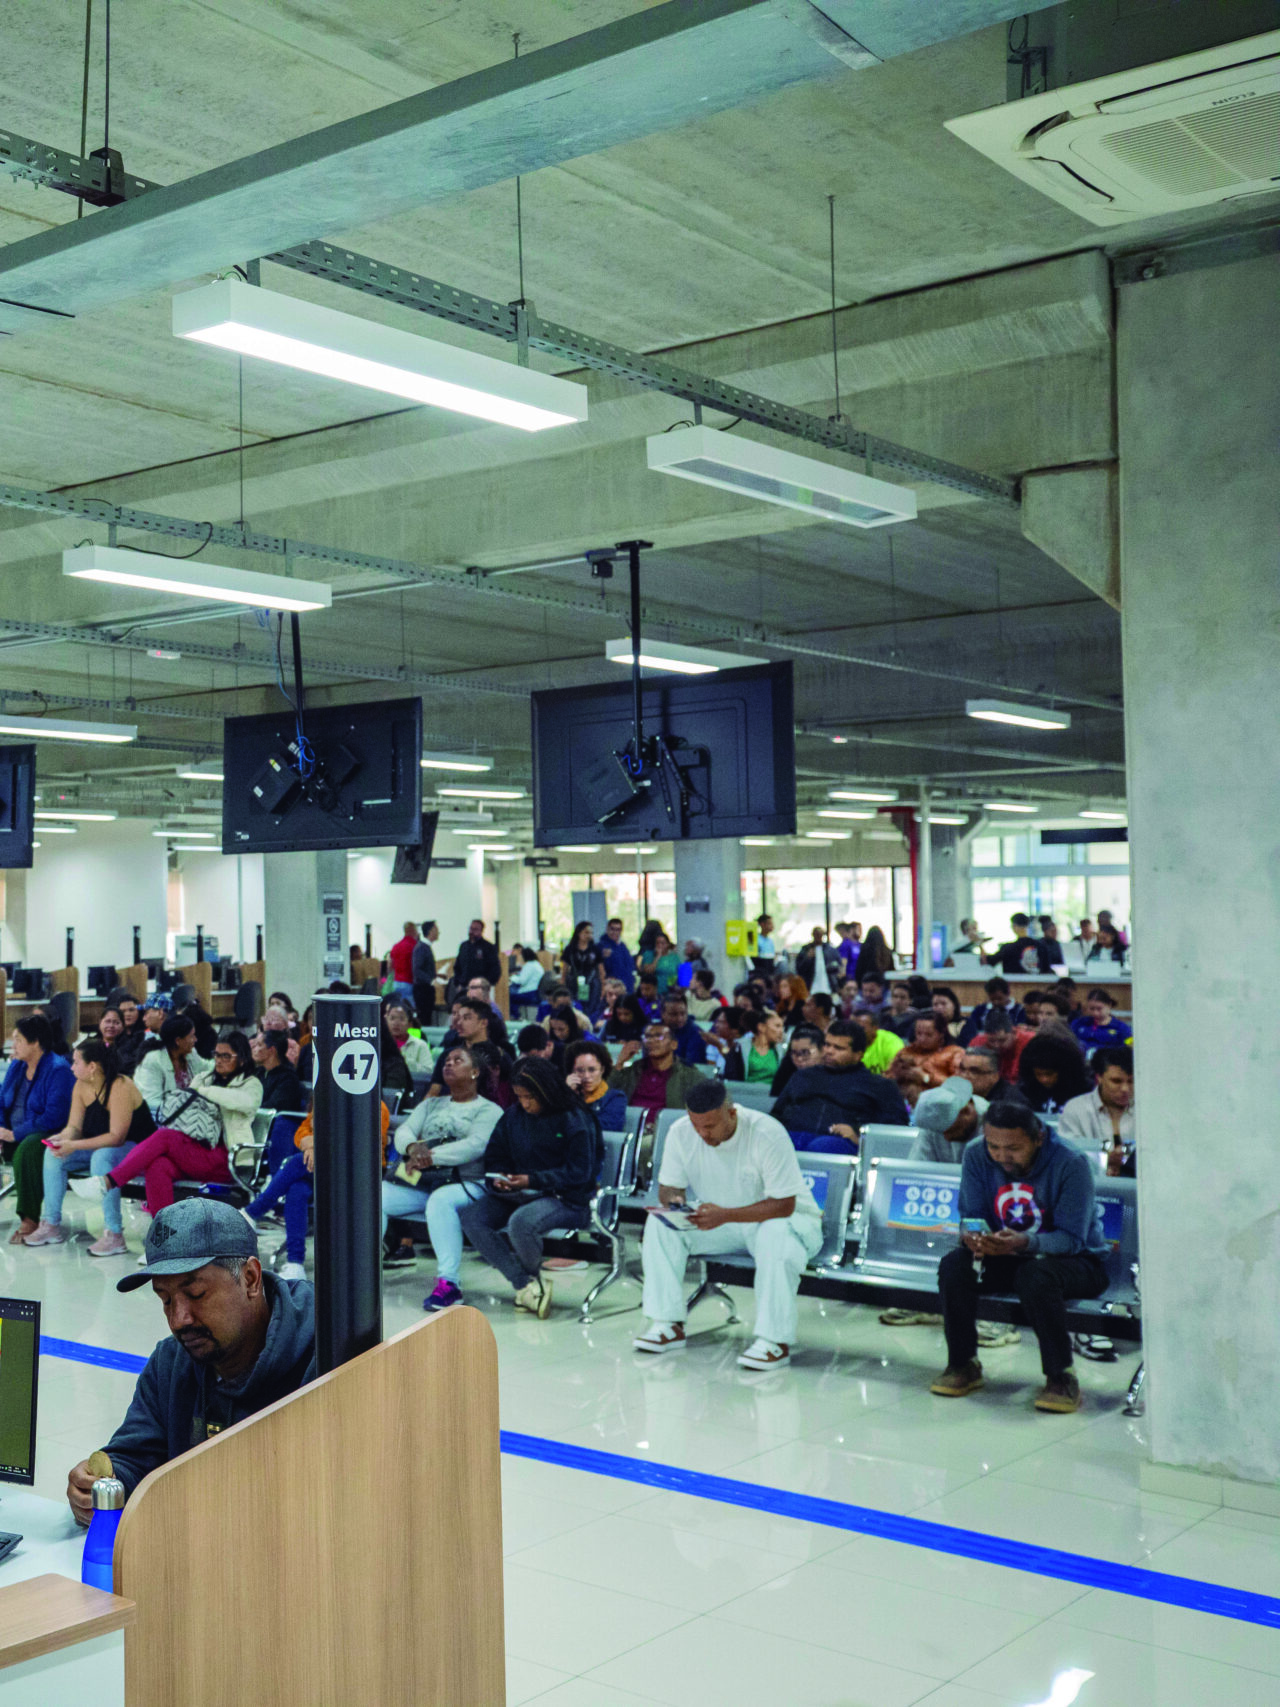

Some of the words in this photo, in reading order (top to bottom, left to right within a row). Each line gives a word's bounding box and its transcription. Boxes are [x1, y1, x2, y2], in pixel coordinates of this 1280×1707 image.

[1211, 91, 1256, 106] ELGIN
[333, 1023, 377, 1038] Mesa
[338, 1054, 375, 1081] 47
